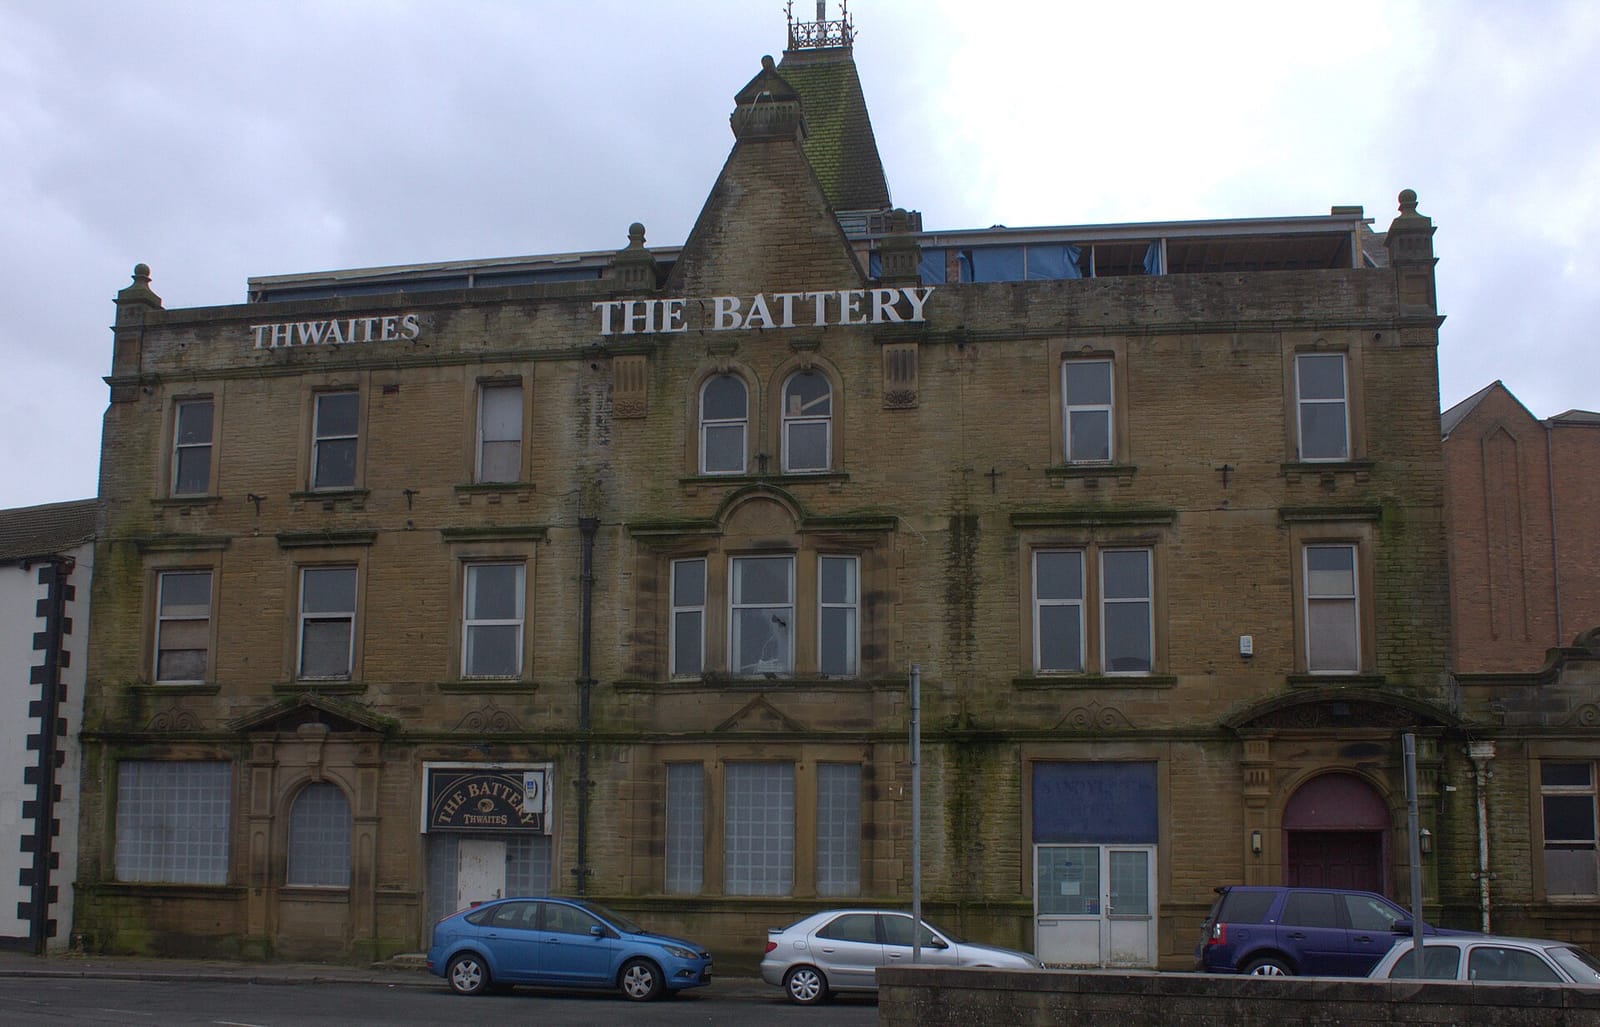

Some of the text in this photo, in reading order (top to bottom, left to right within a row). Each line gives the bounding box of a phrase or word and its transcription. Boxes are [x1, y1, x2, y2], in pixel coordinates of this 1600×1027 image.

[592, 286, 936, 335] THE BATTERY
[249, 313, 420, 349] THWAITES
[438, 790, 467, 824] THE
[463, 814, 508, 825] THWAITES
